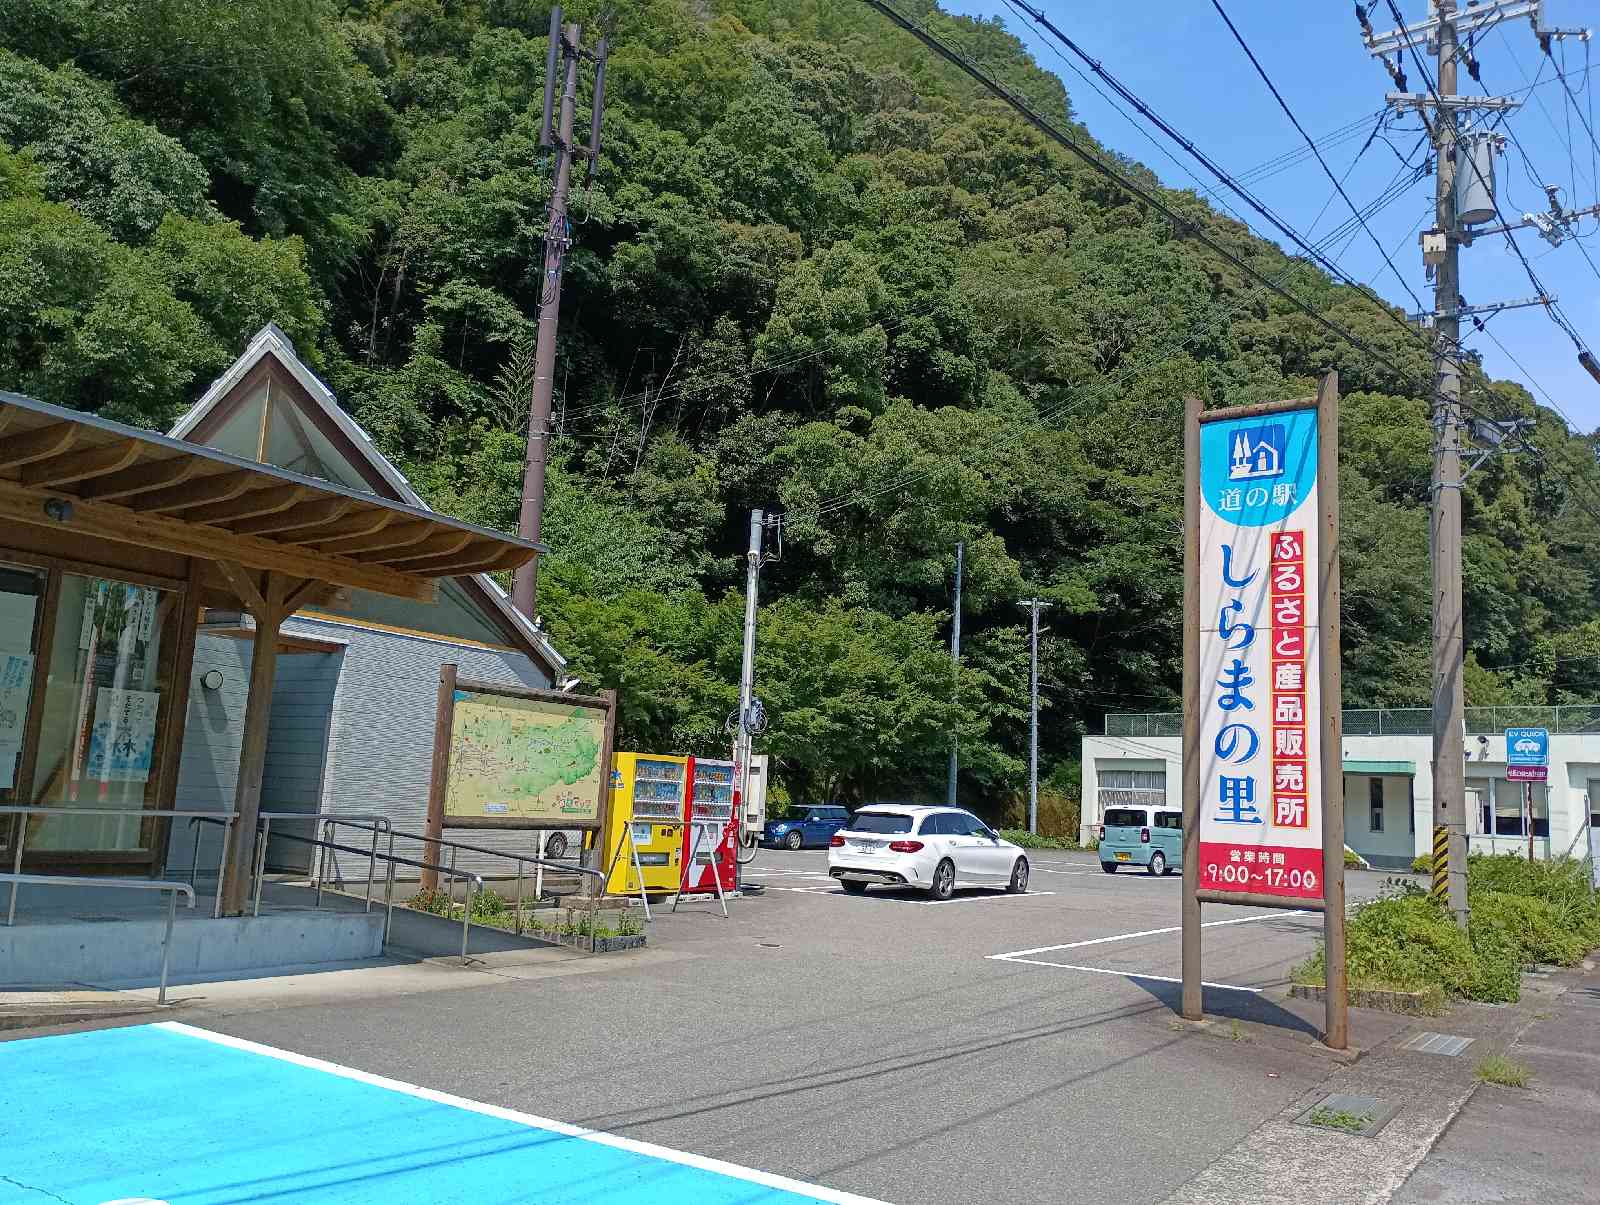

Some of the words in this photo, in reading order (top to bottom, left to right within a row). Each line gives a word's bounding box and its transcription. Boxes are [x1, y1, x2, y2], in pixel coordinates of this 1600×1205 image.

[1218, 482, 1299, 512] 道の駅
[1213, 544, 1264, 825] しらまの里
[1273, 535, 1305, 826] ふるさと産品販売所
[1230, 849, 1286, 866] 営業時間
